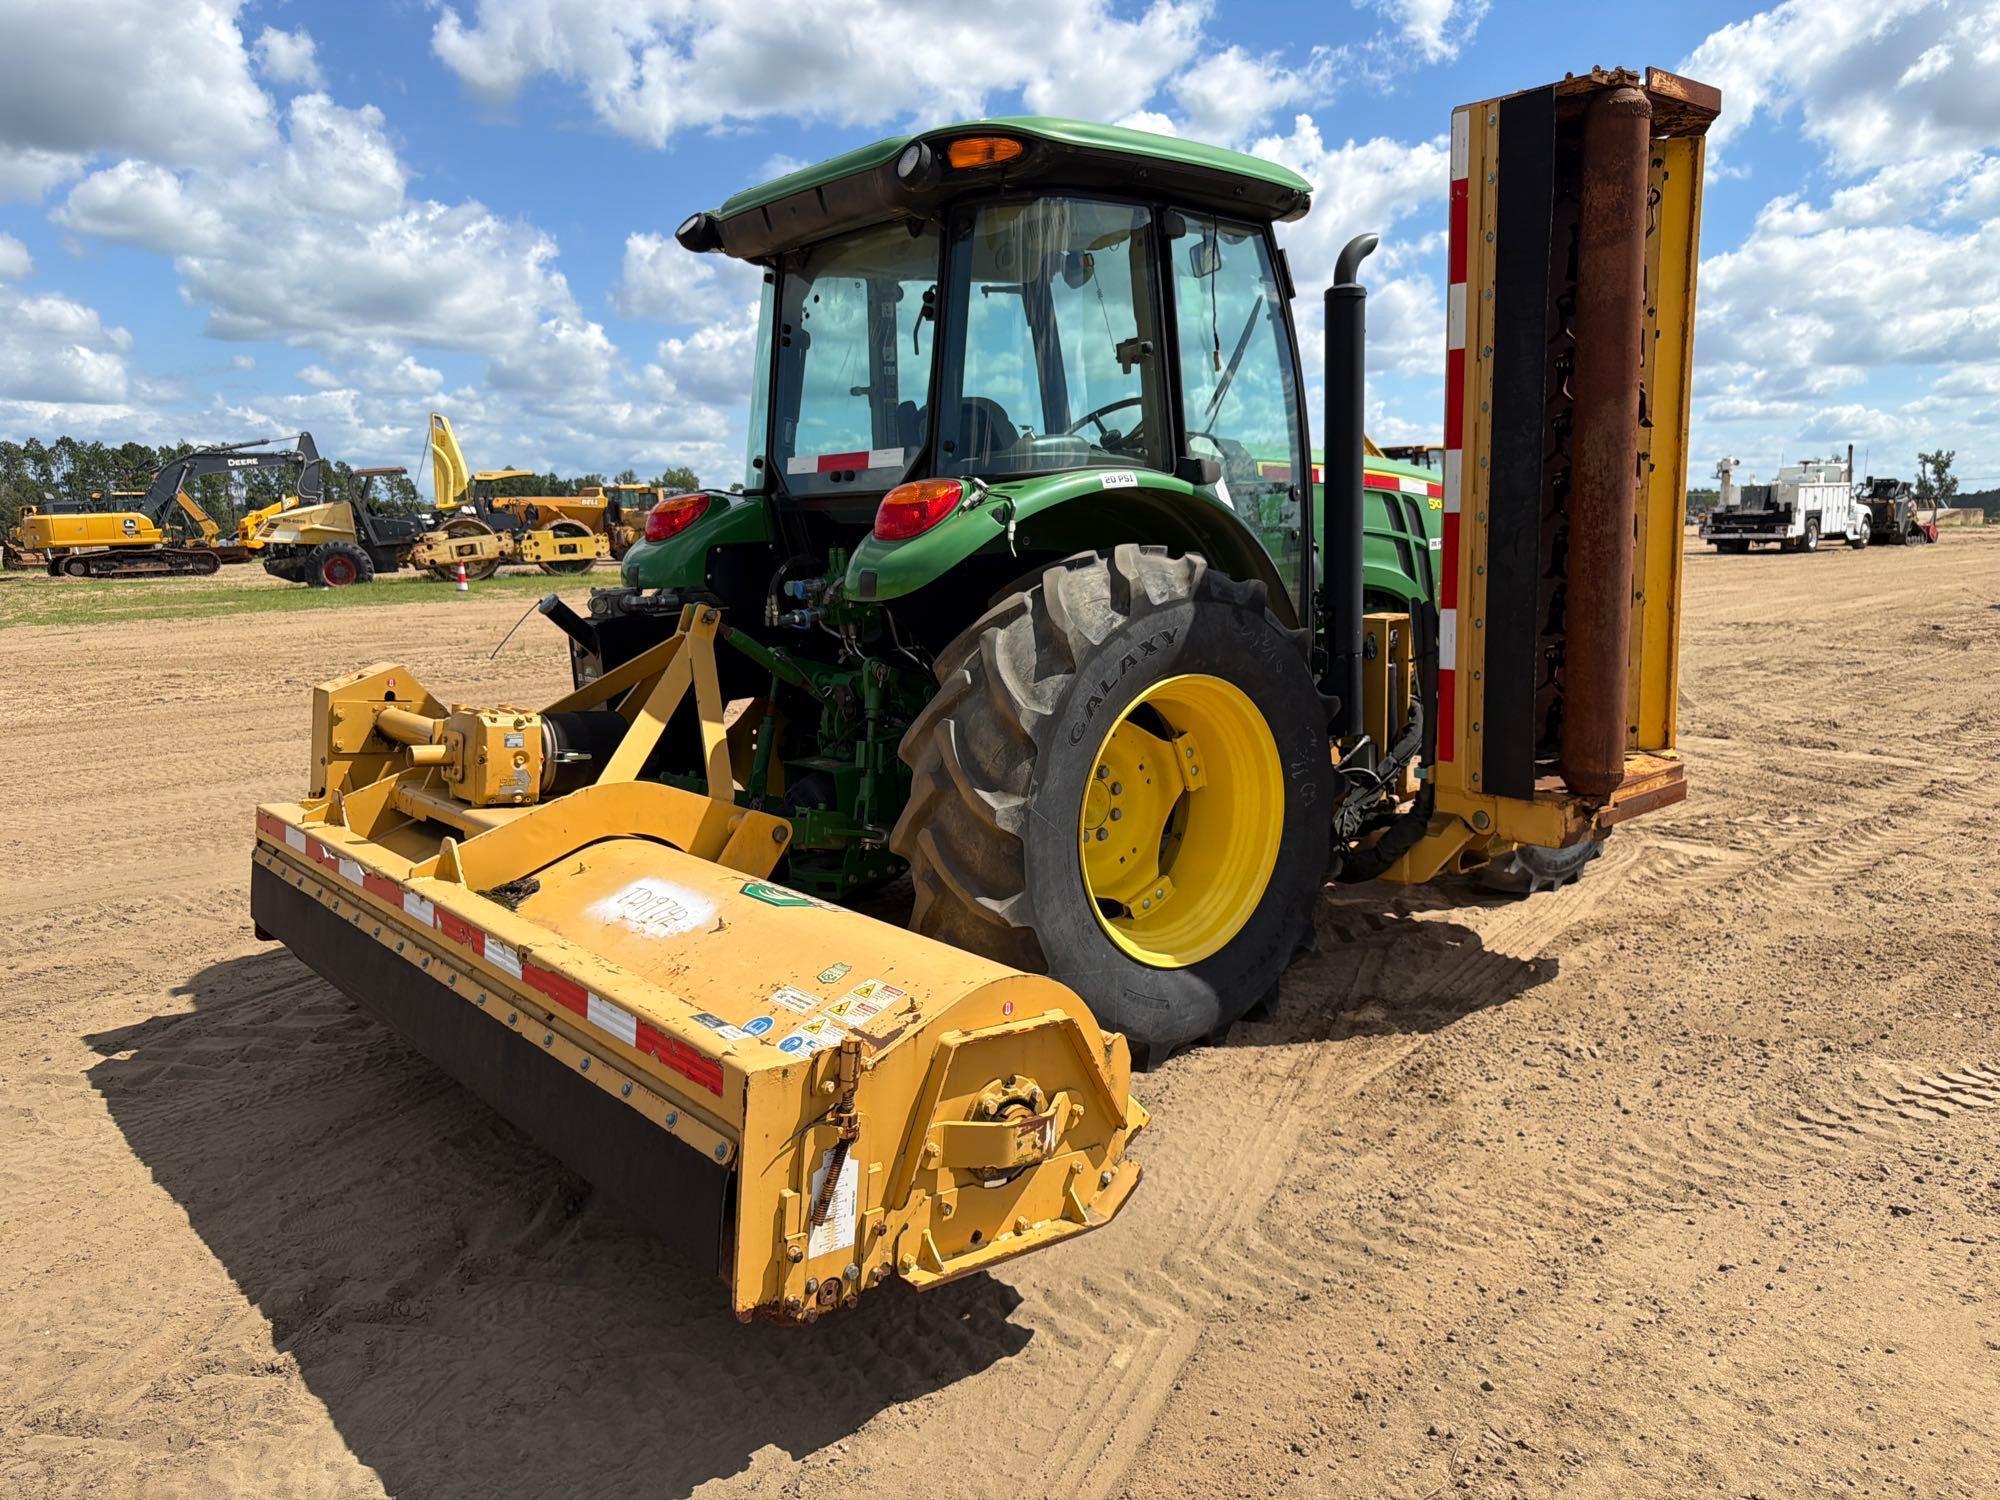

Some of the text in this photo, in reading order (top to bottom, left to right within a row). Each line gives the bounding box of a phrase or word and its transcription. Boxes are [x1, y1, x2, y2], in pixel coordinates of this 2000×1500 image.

[227, 458, 259, 467] DEERE
[1104, 474, 1134, 484] 20 PSI
[1069, 627, 1180, 747] GALAXY
